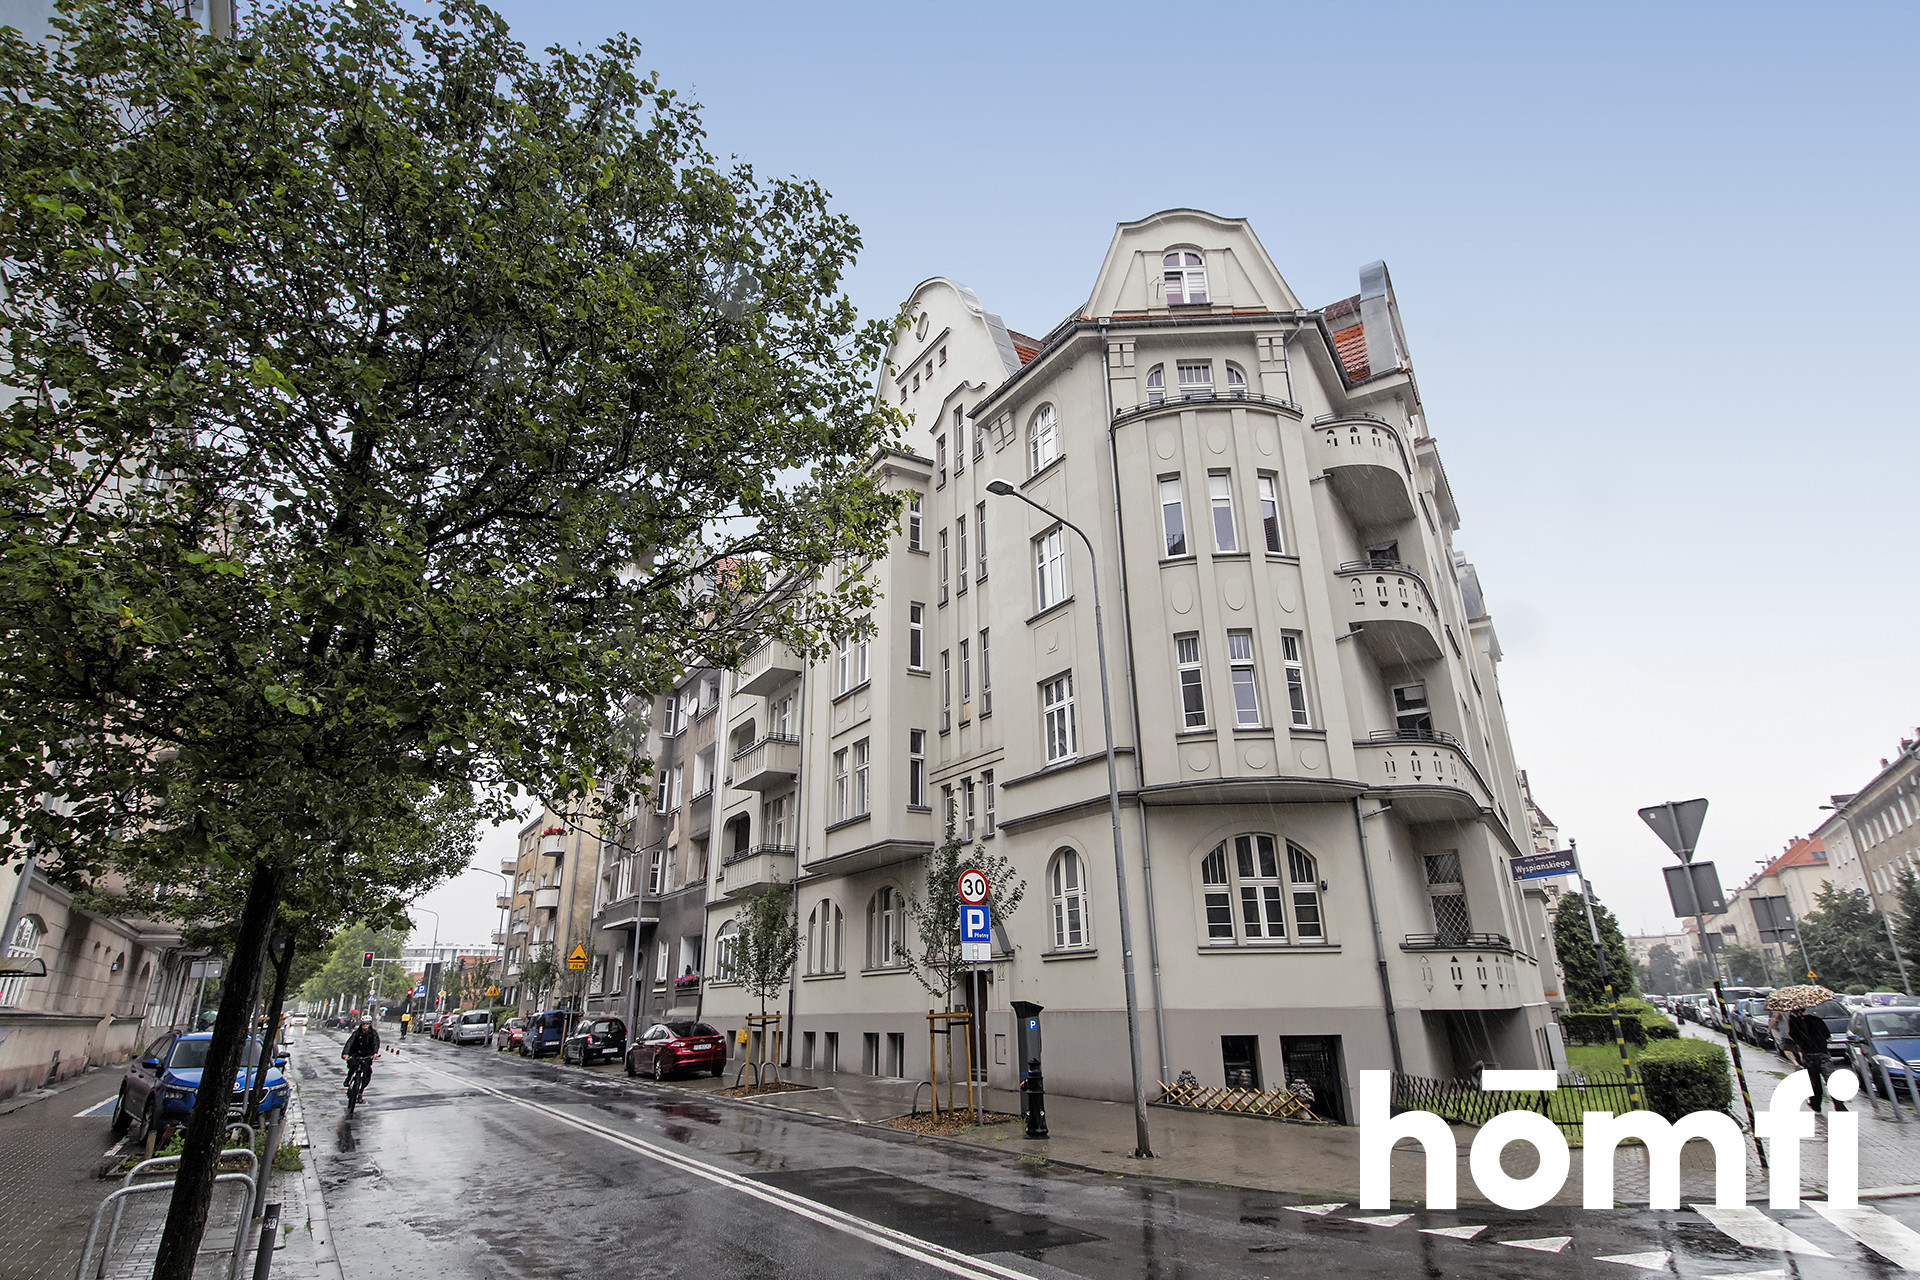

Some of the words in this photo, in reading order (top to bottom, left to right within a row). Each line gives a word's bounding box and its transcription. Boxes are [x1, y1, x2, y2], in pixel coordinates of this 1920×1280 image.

[1514, 860, 1571, 875] Wyspiańskiego
[964, 879, 985, 896] 30
[967, 909, 985, 938] P
[1030, 1020, 1036, 1029] P
